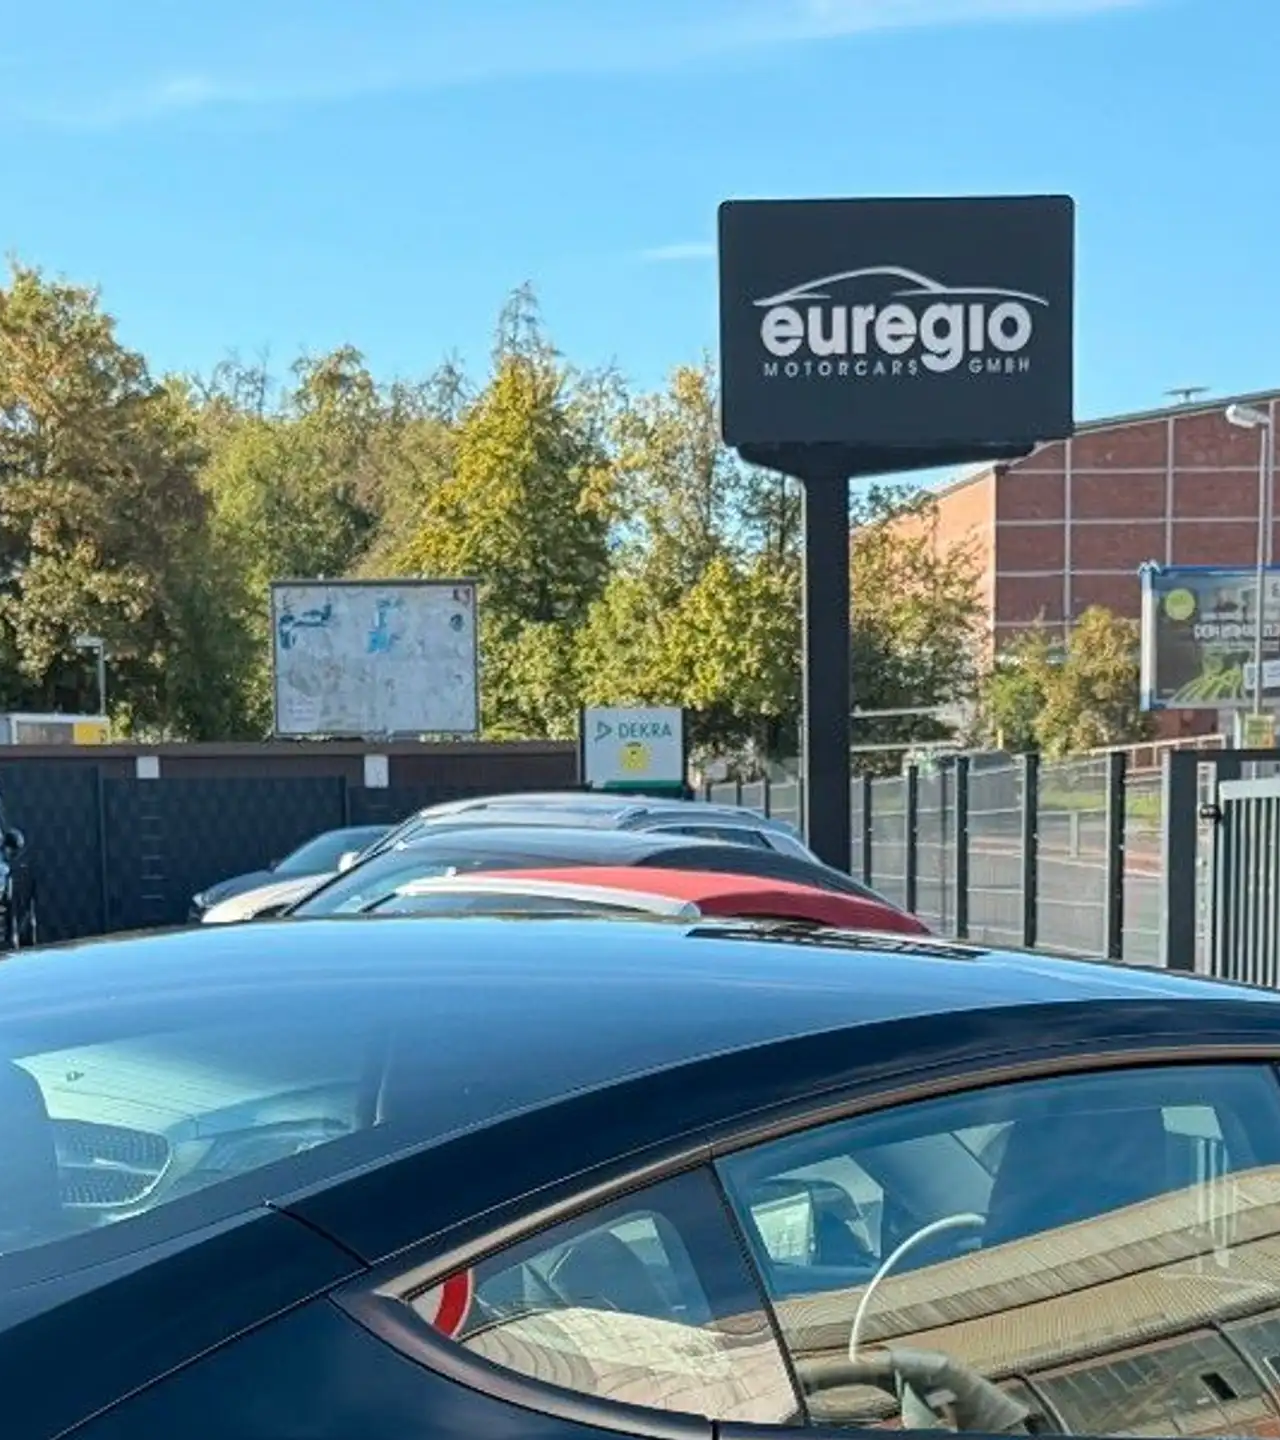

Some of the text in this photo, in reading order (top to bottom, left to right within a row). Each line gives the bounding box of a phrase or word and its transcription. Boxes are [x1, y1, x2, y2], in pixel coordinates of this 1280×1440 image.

[760, 302, 1032, 372] euregio
[764, 356, 1030, 379] MOTORCARS GMBH
[618, 721, 672, 739] DEKRA
